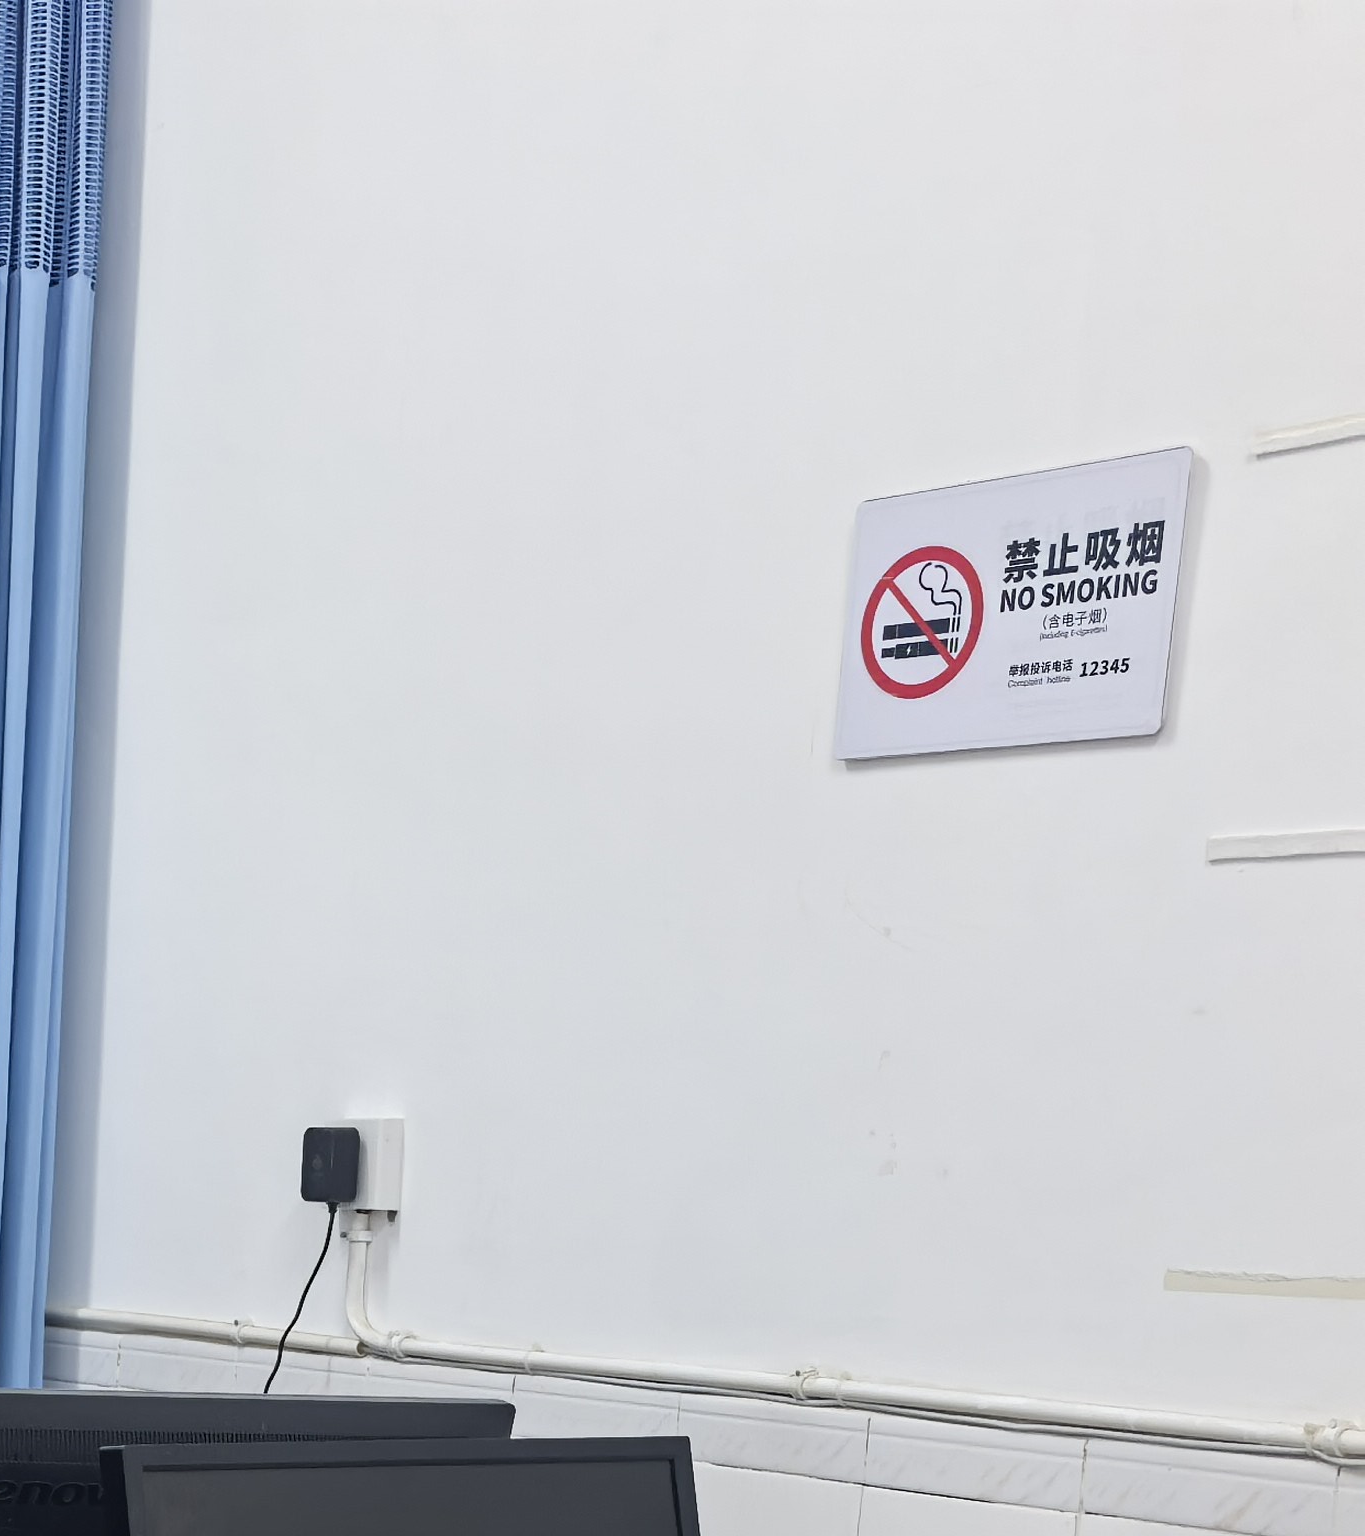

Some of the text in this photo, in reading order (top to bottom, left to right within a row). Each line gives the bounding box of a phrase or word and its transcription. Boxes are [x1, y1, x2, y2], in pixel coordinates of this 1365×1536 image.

[1003, 520, 1165, 584] 禁止吸烟
[1000, 569, 1158, 613] NO SMOKING
[1008, 657, 1130, 678] 举报投诉电话 12345
